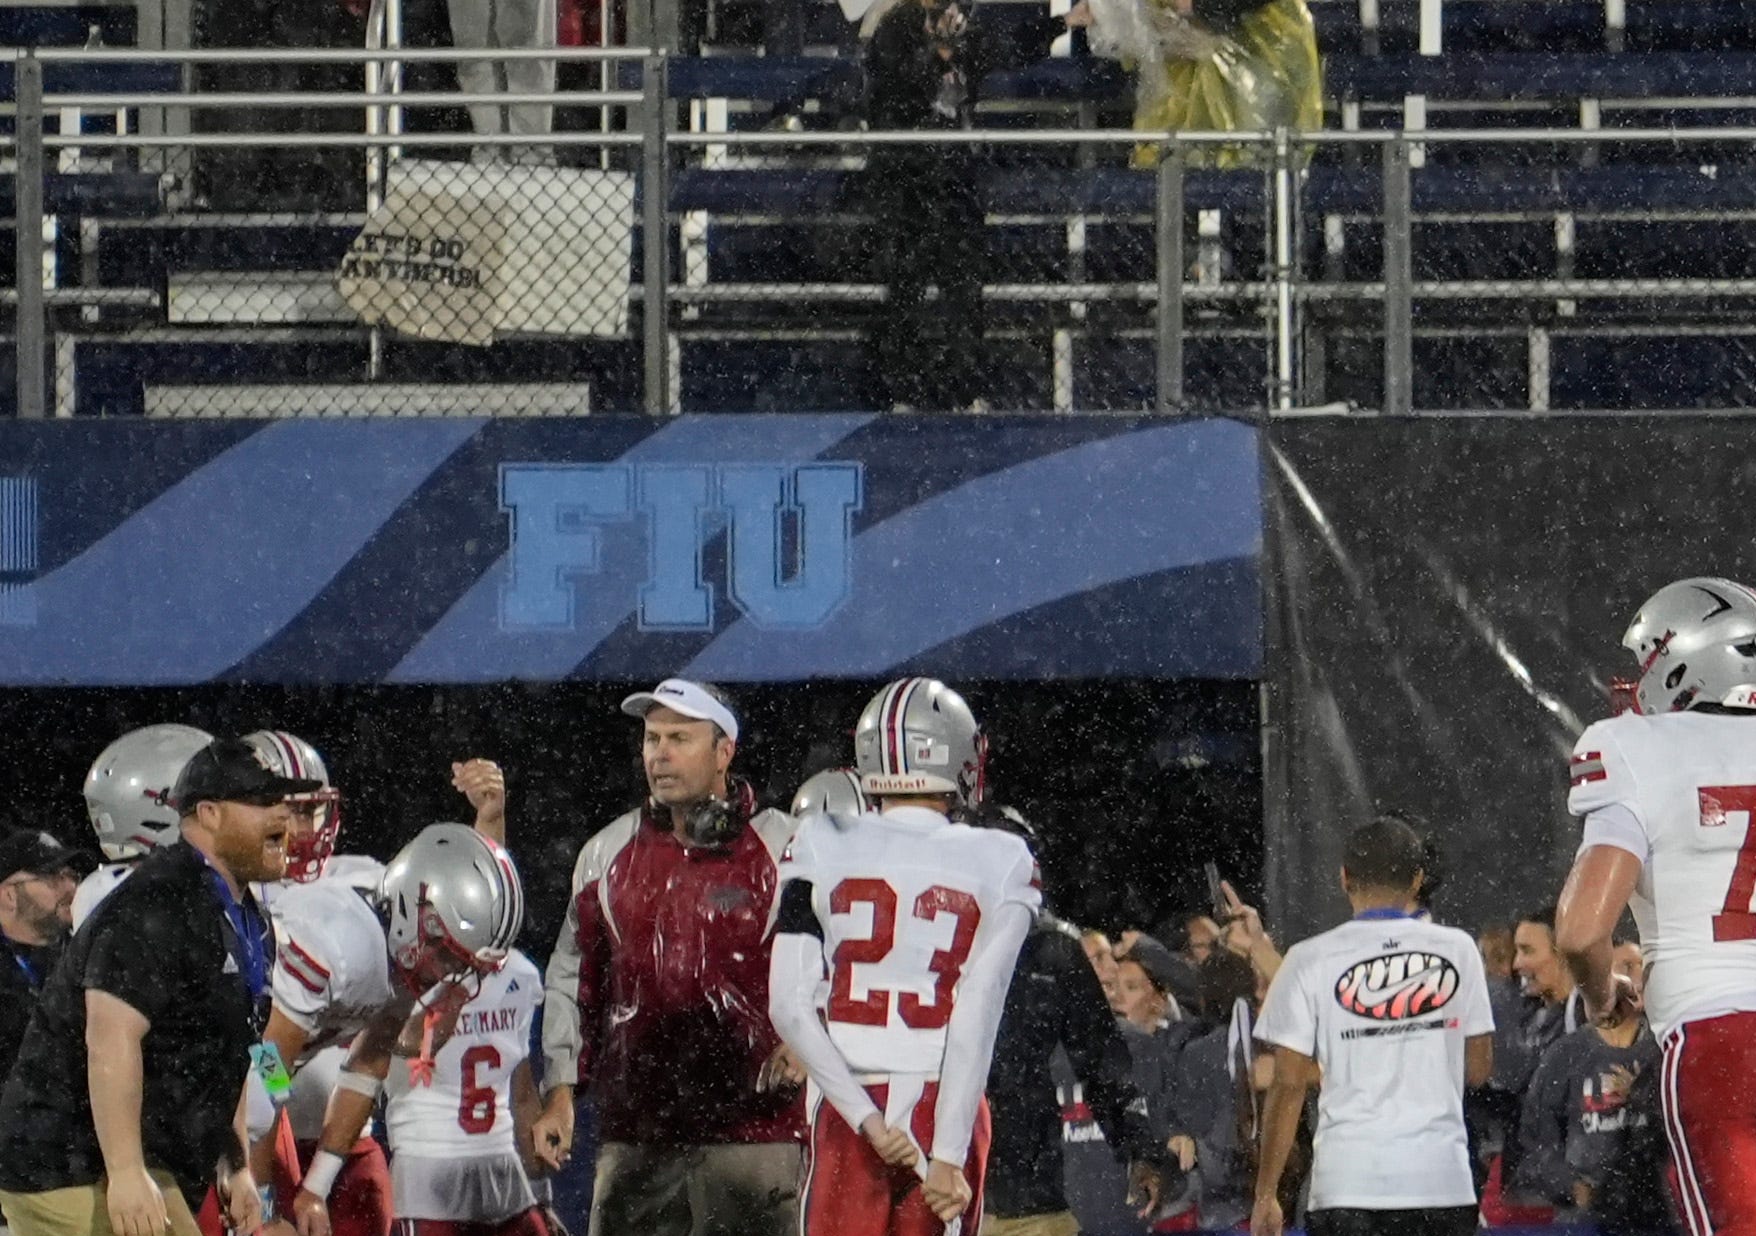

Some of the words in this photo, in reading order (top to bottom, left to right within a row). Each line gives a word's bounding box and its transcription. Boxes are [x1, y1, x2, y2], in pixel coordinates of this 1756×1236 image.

[498, 461, 864, 632] FIU
[828, 878, 982, 1030] 23
[479, 1008, 518, 1034] MARY
[458, 1044, 501, 1135] 6
